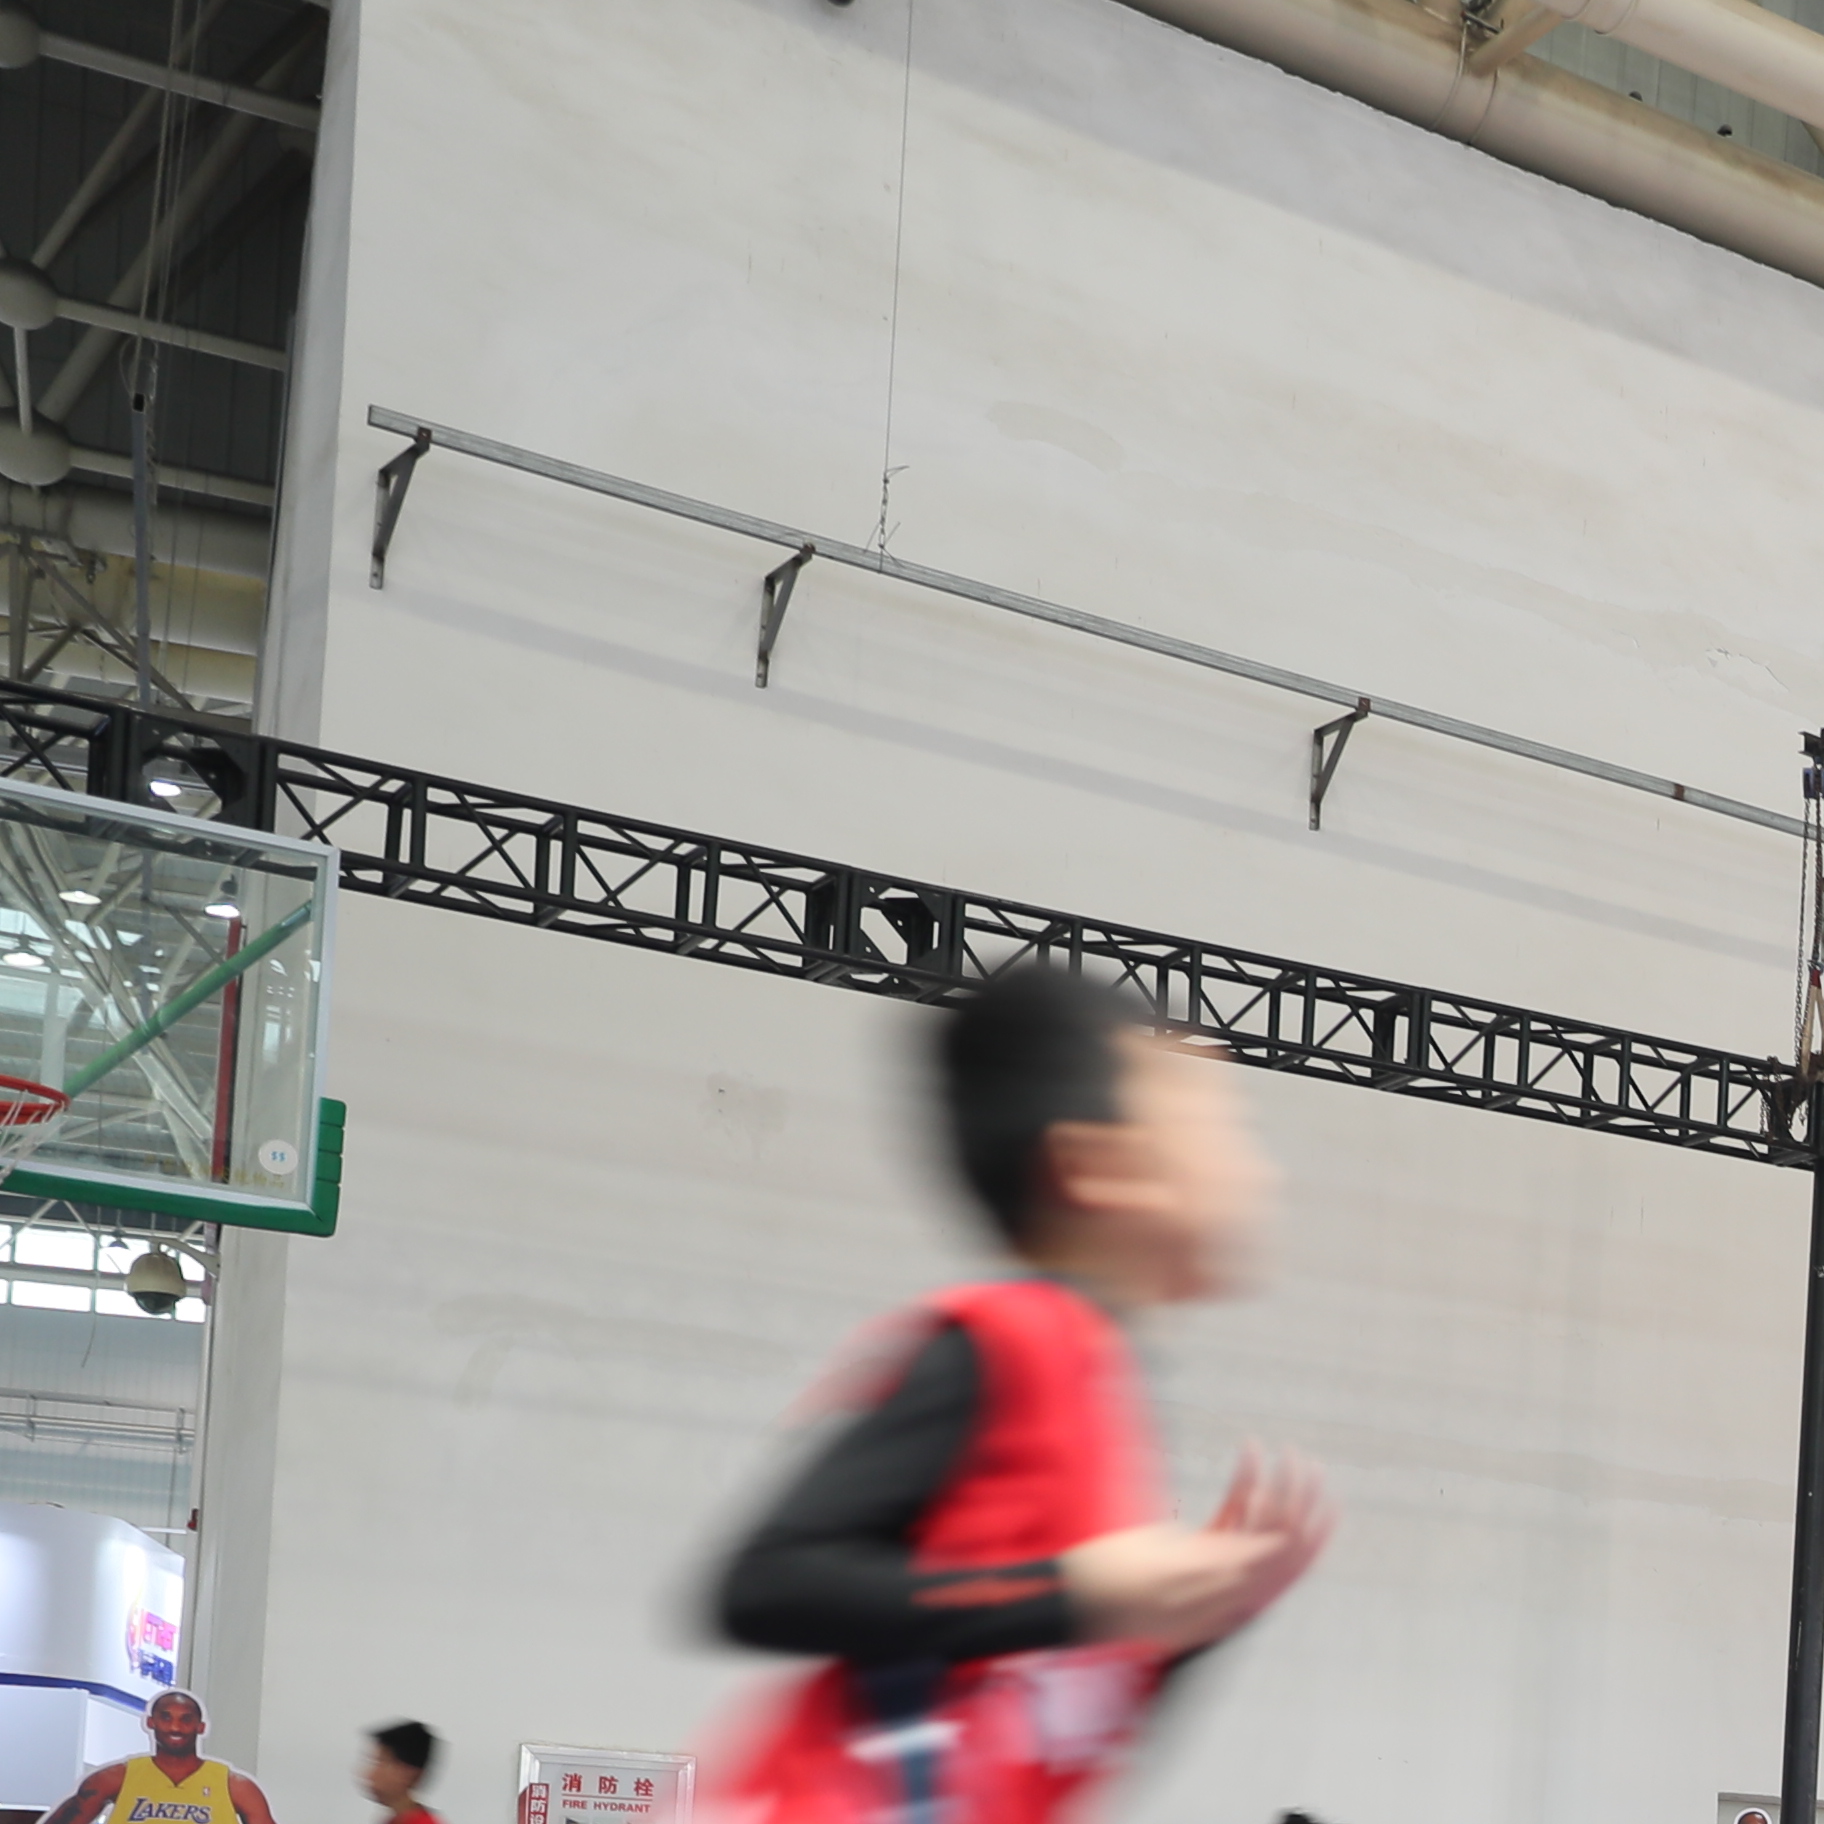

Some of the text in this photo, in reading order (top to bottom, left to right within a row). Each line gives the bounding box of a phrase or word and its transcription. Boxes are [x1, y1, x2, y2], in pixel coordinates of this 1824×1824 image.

[562, 1773, 654, 1798] 消防栓
[127, 1797, 212, 1824] LAKERS
[562, 1800, 651, 1813] FIRE HYDRANT
